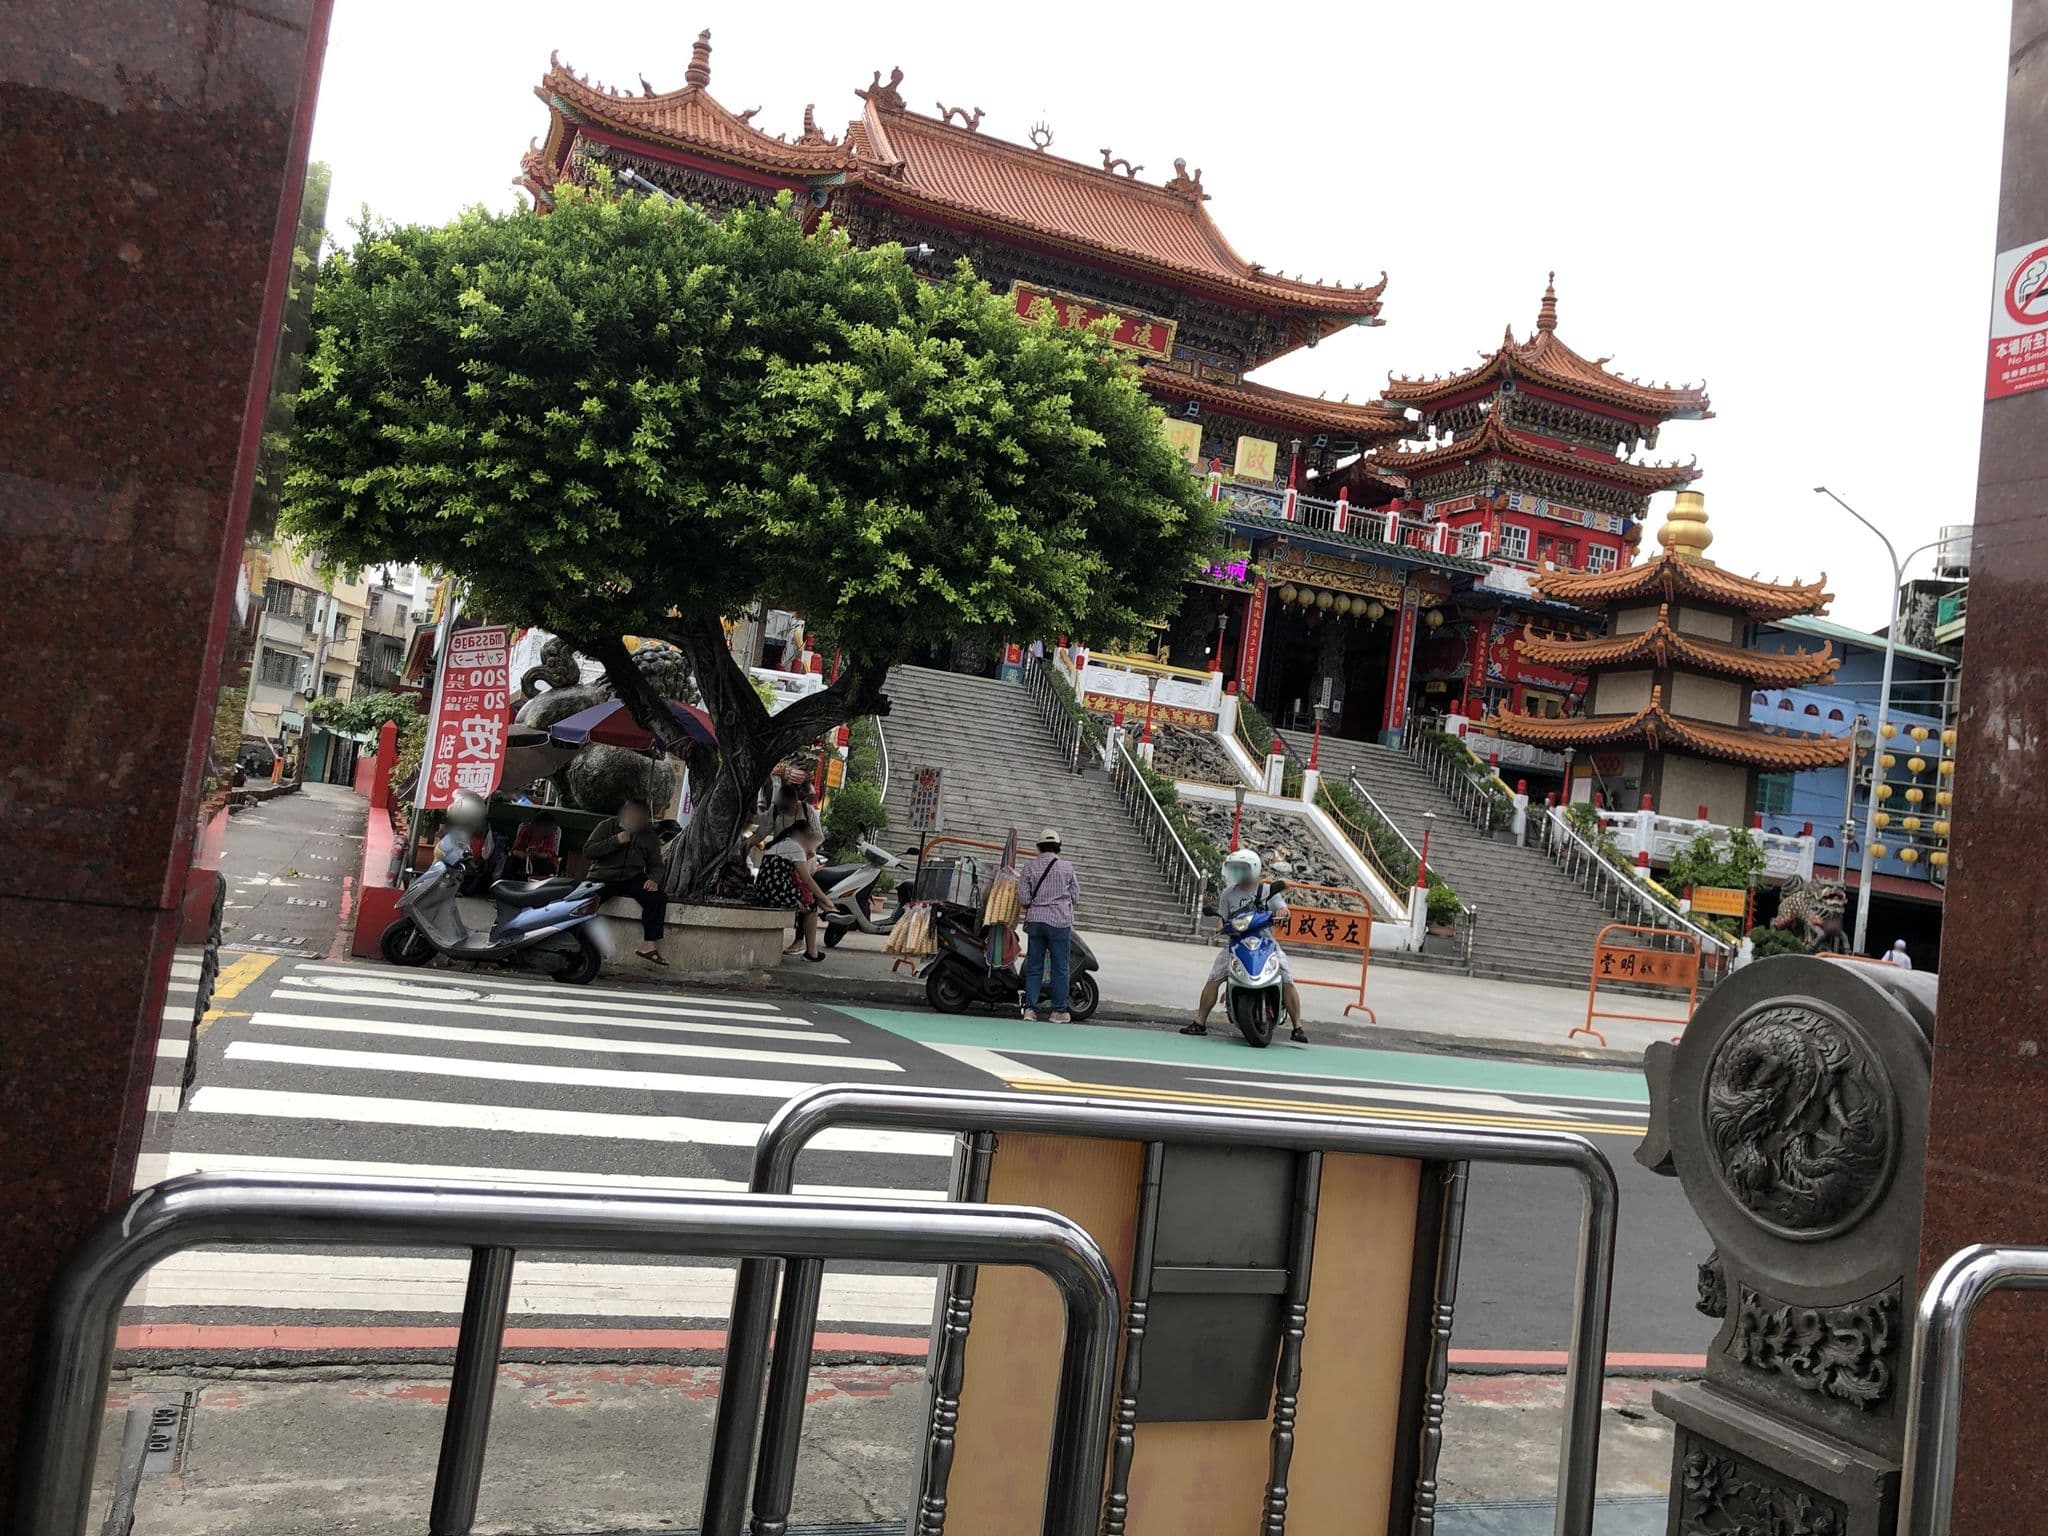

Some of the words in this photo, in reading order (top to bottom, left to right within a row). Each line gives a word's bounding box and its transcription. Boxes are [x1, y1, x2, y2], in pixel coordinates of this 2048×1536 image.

[1995, 330, 2048, 359] 本場所全
[2008, 356, 2022, 366] No
